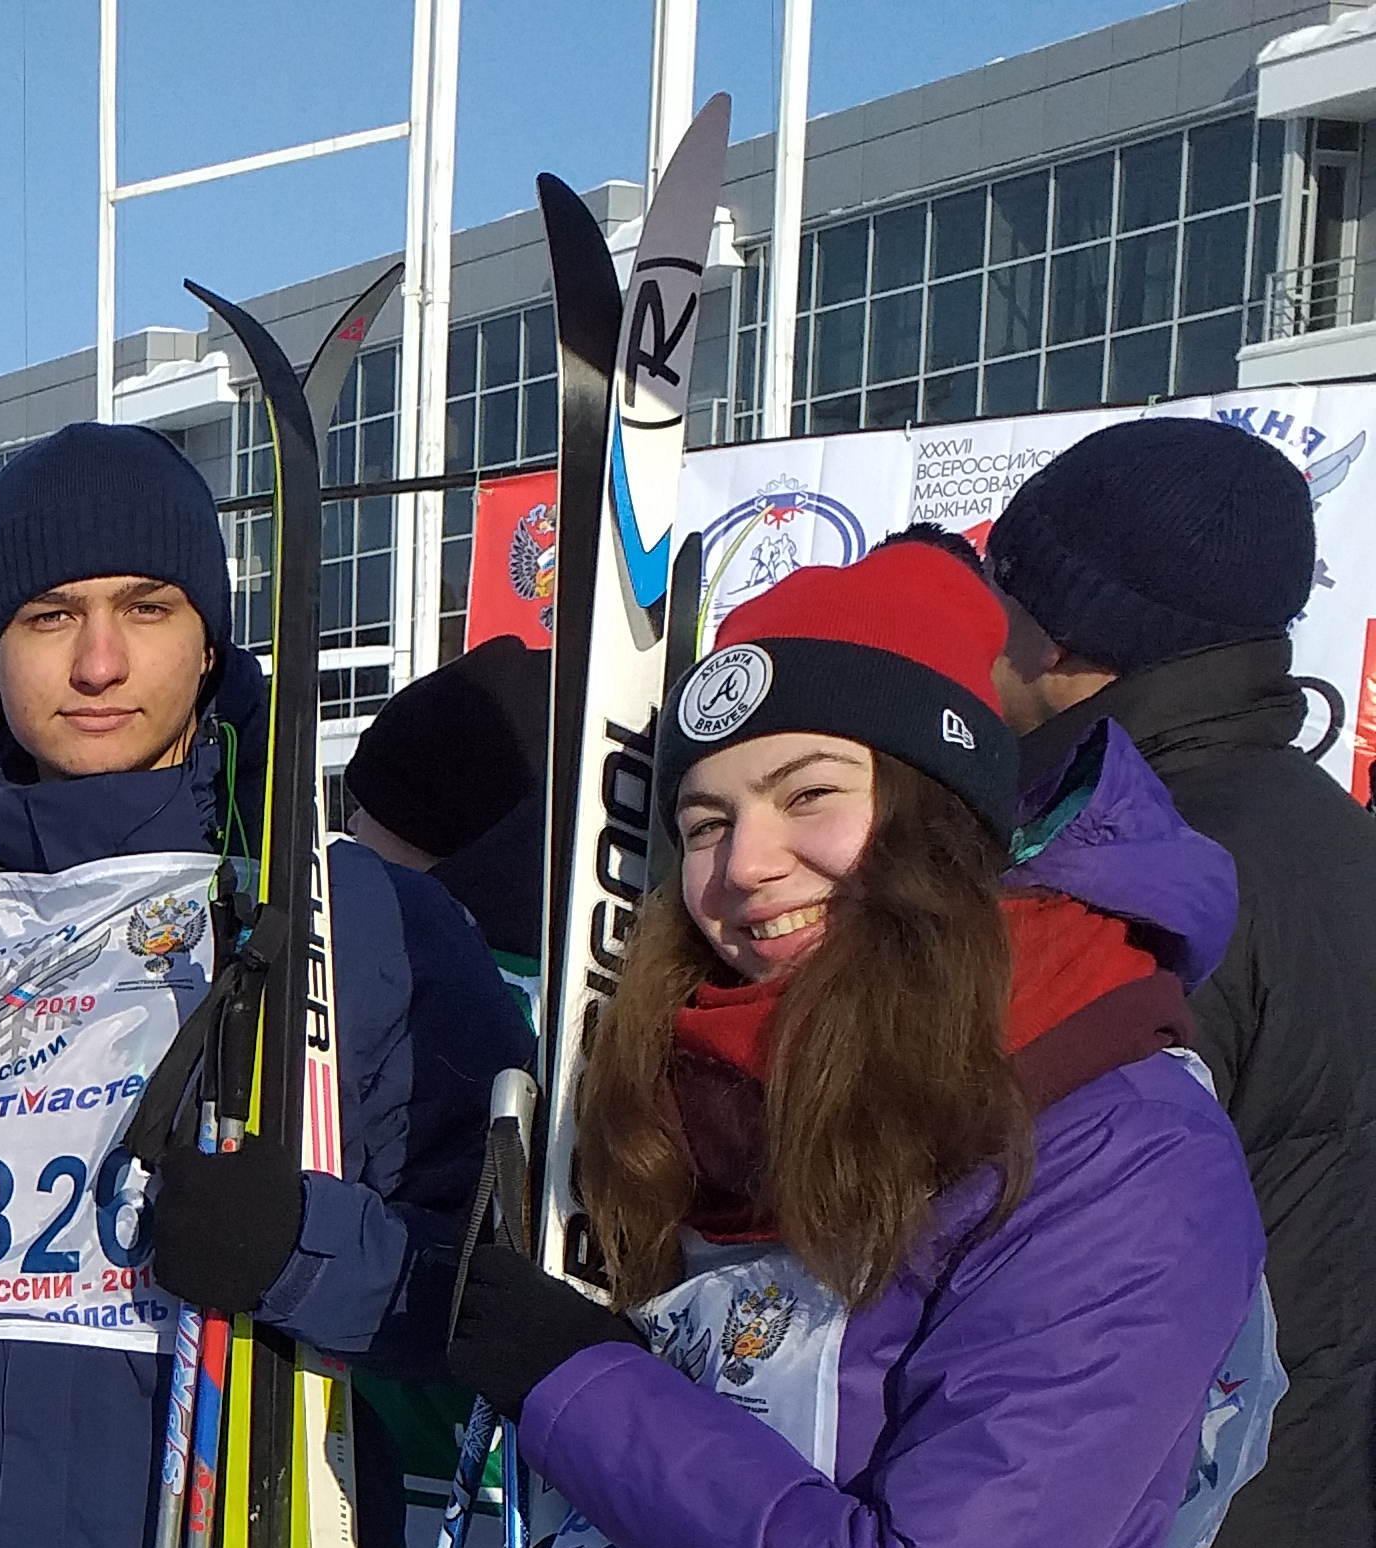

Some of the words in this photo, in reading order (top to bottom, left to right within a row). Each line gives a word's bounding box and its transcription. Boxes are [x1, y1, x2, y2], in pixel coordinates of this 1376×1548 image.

[1216, 406, 1327, 458] ЖНЯ
[918, 438, 973, 460] XXXVII
[913, 473, 1025, 501] МАССОВАЯ
[911, 497, 993, 522] ЛЫЖНАЯ
[700, 652, 754, 681] ATLANTA
[693, 702, 750, 733] BRAVES
[33, 994, 96, 1018] 2019
[101, 1266, 150, 1293] 201
